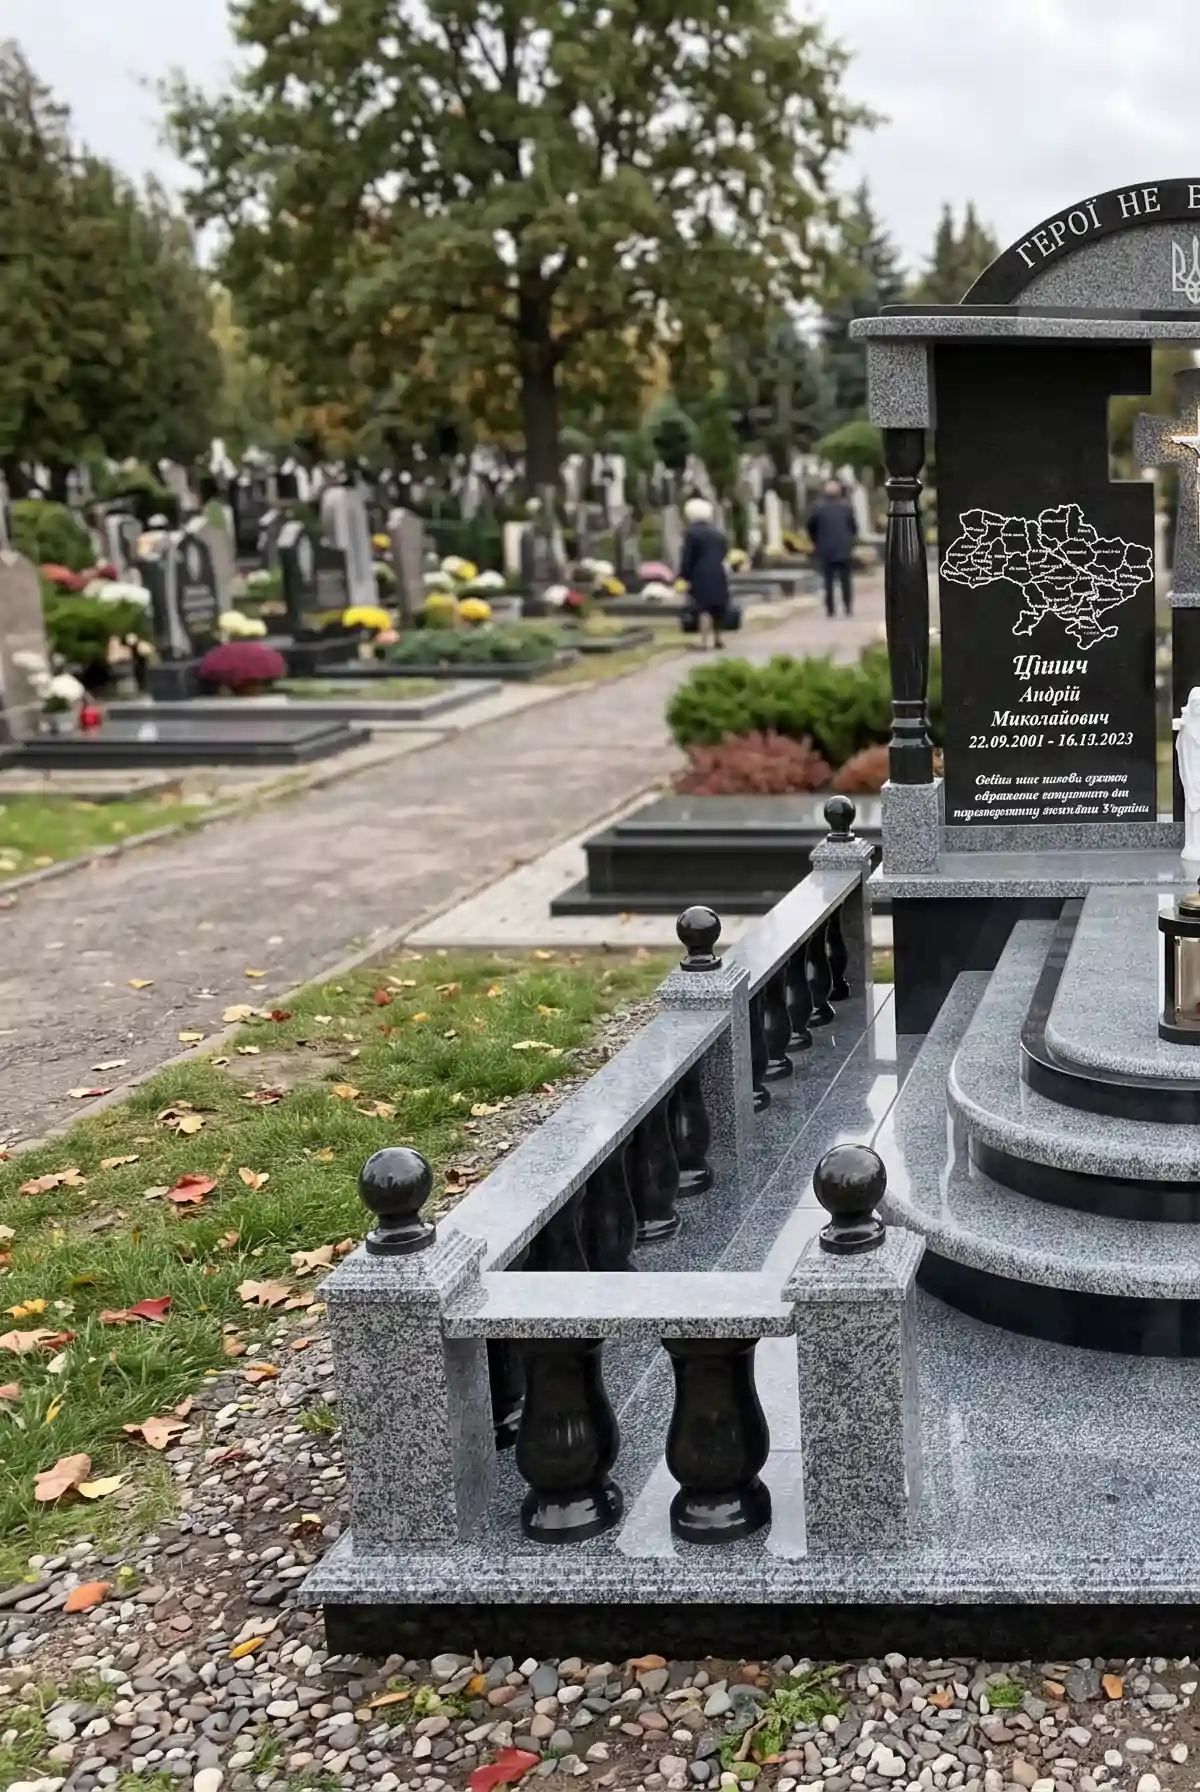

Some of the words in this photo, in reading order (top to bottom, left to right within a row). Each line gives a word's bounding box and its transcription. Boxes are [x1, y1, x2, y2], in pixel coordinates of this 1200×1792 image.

[1015, 198, 1103, 269] ГЕРОЇ
[1116, 187, 1162, 220] НЕ
[990, 710, 1110, 727] Миколайович
[968, 734, 1045, 749] 22.09.2001
